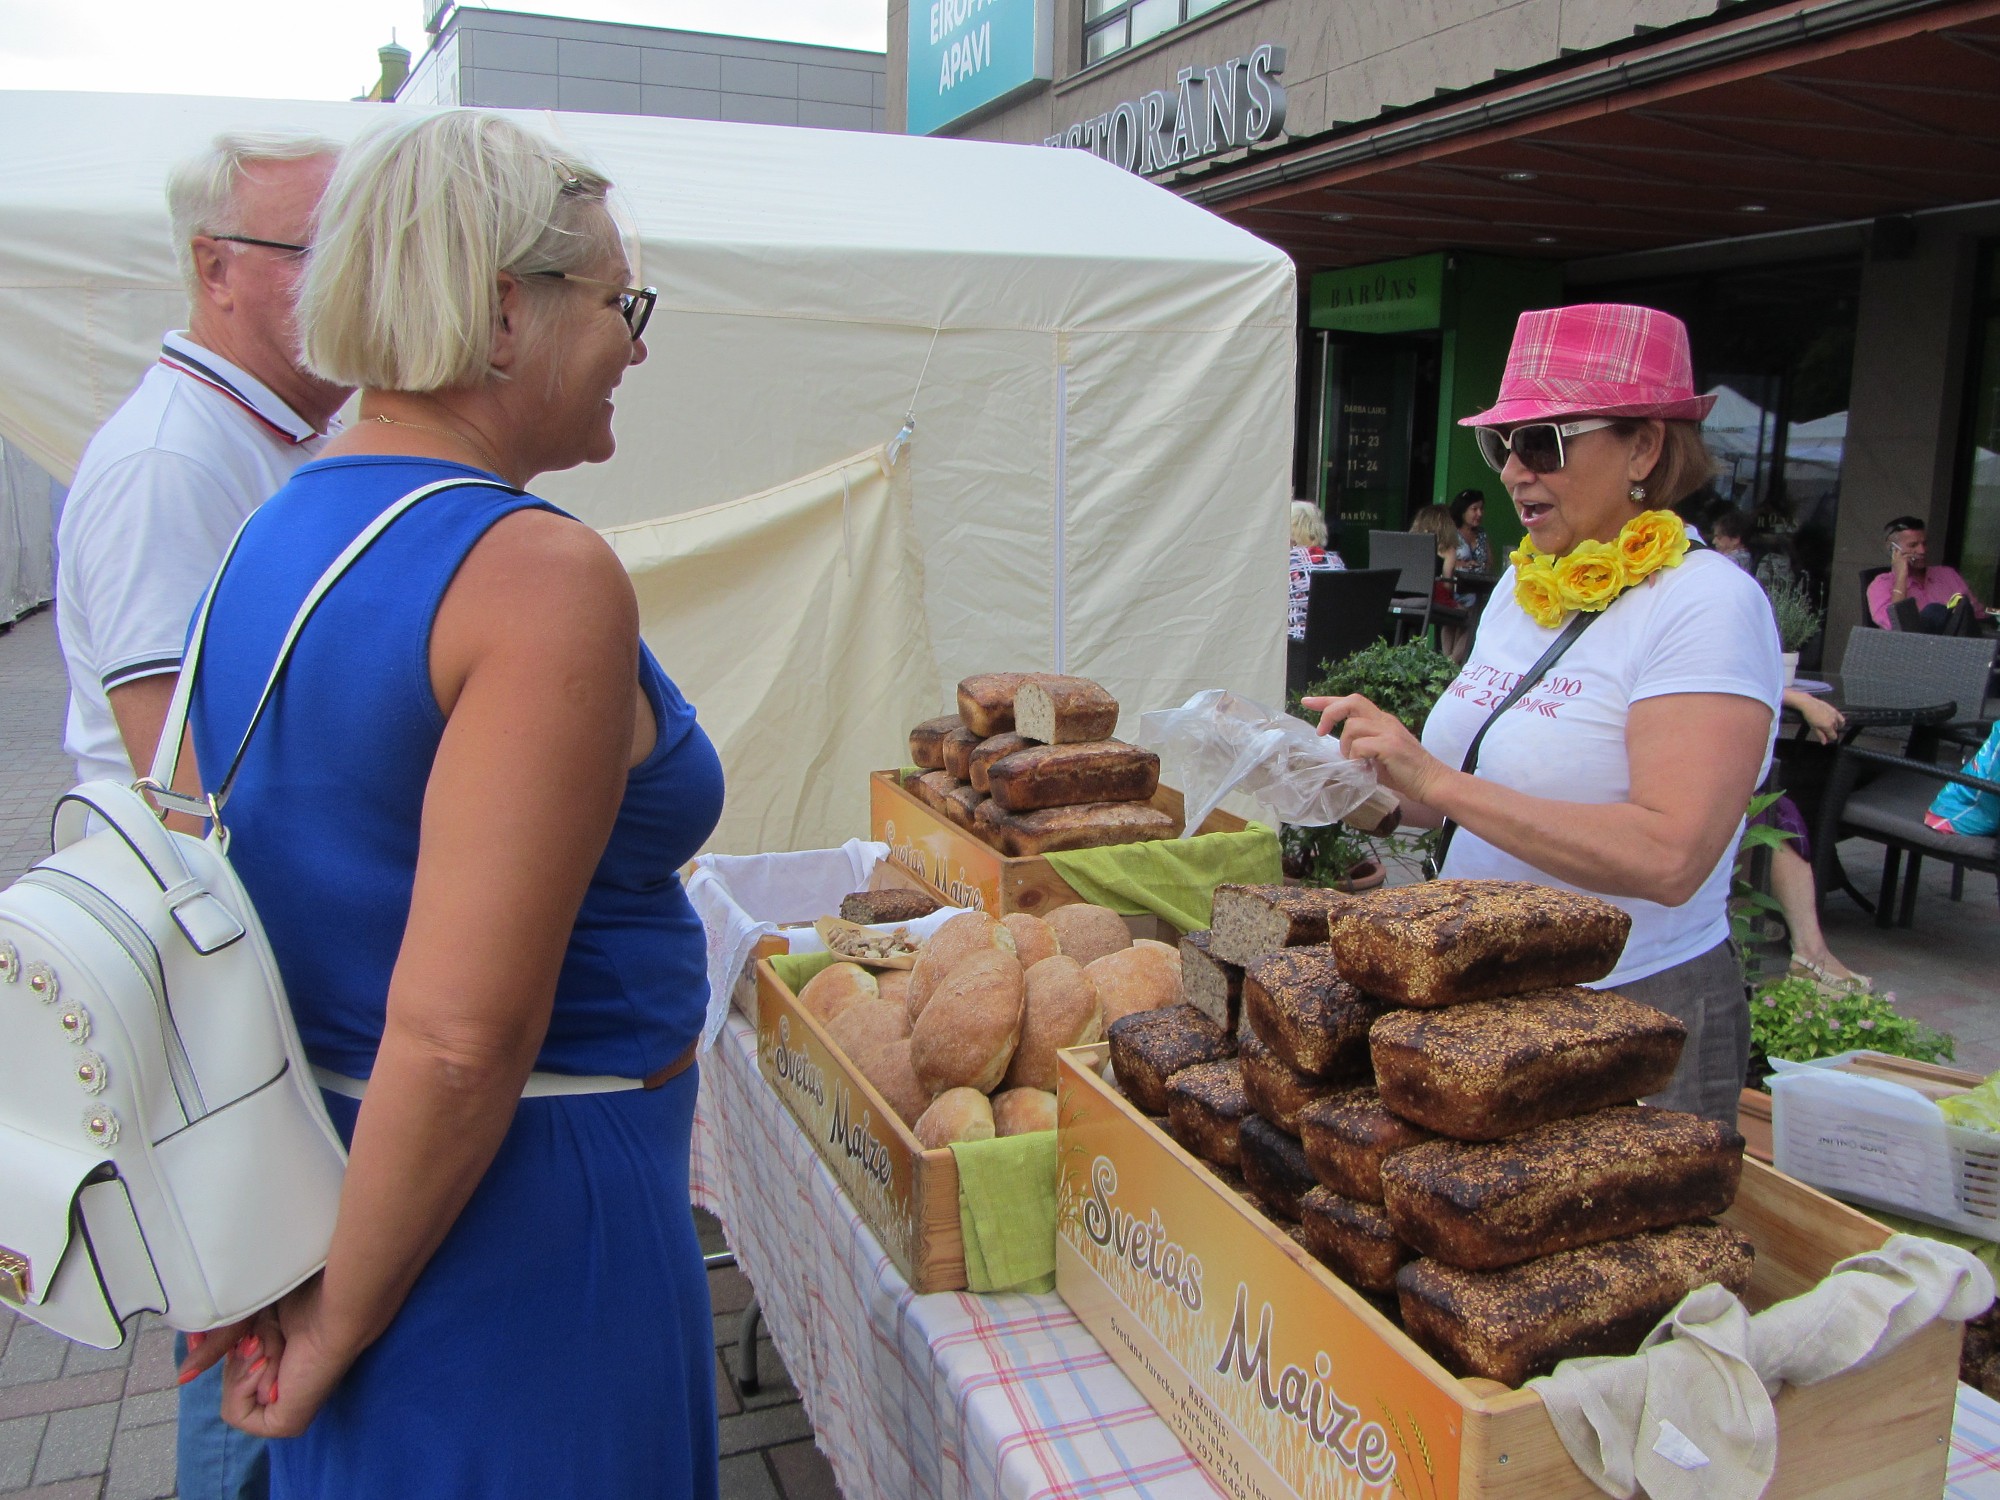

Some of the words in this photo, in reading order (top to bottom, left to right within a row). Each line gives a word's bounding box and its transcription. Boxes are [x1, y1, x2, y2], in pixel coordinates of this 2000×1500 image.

[938, 20, 992, 96] APAVI
[1044, 43, 1275, 175] TORĀNS
[1343, 405, 1366, 414] DARBA
[1367, 406, 1387, 415] LAIKS
[1349, 434, 1359, 446] 11
[1368, 435, 1380, 447] 23
[1347, 459, 1358, 471] 11
[1366, 460, 1378, 472] 24
[933, 850, 984, 912] Maize
[775, 1014, 825, 1108] Svetas
[829, 1078, 893, 1187] Maize
[1083, 1156, 1203, 1313] Svetas
[1215, 1281, 1396, 1487] Maize
[1110, 1316, 1143, 1363] Svetlana
[1180, 1396, 1206, 1436] Kuršu
[1207, 1427, 1225, 1459] iela
[1227, 1452, 1243, 1481] 24,
[1172, 1412, 1193, 1444] +371
[1196, 1438, 1213, 1467] 292
